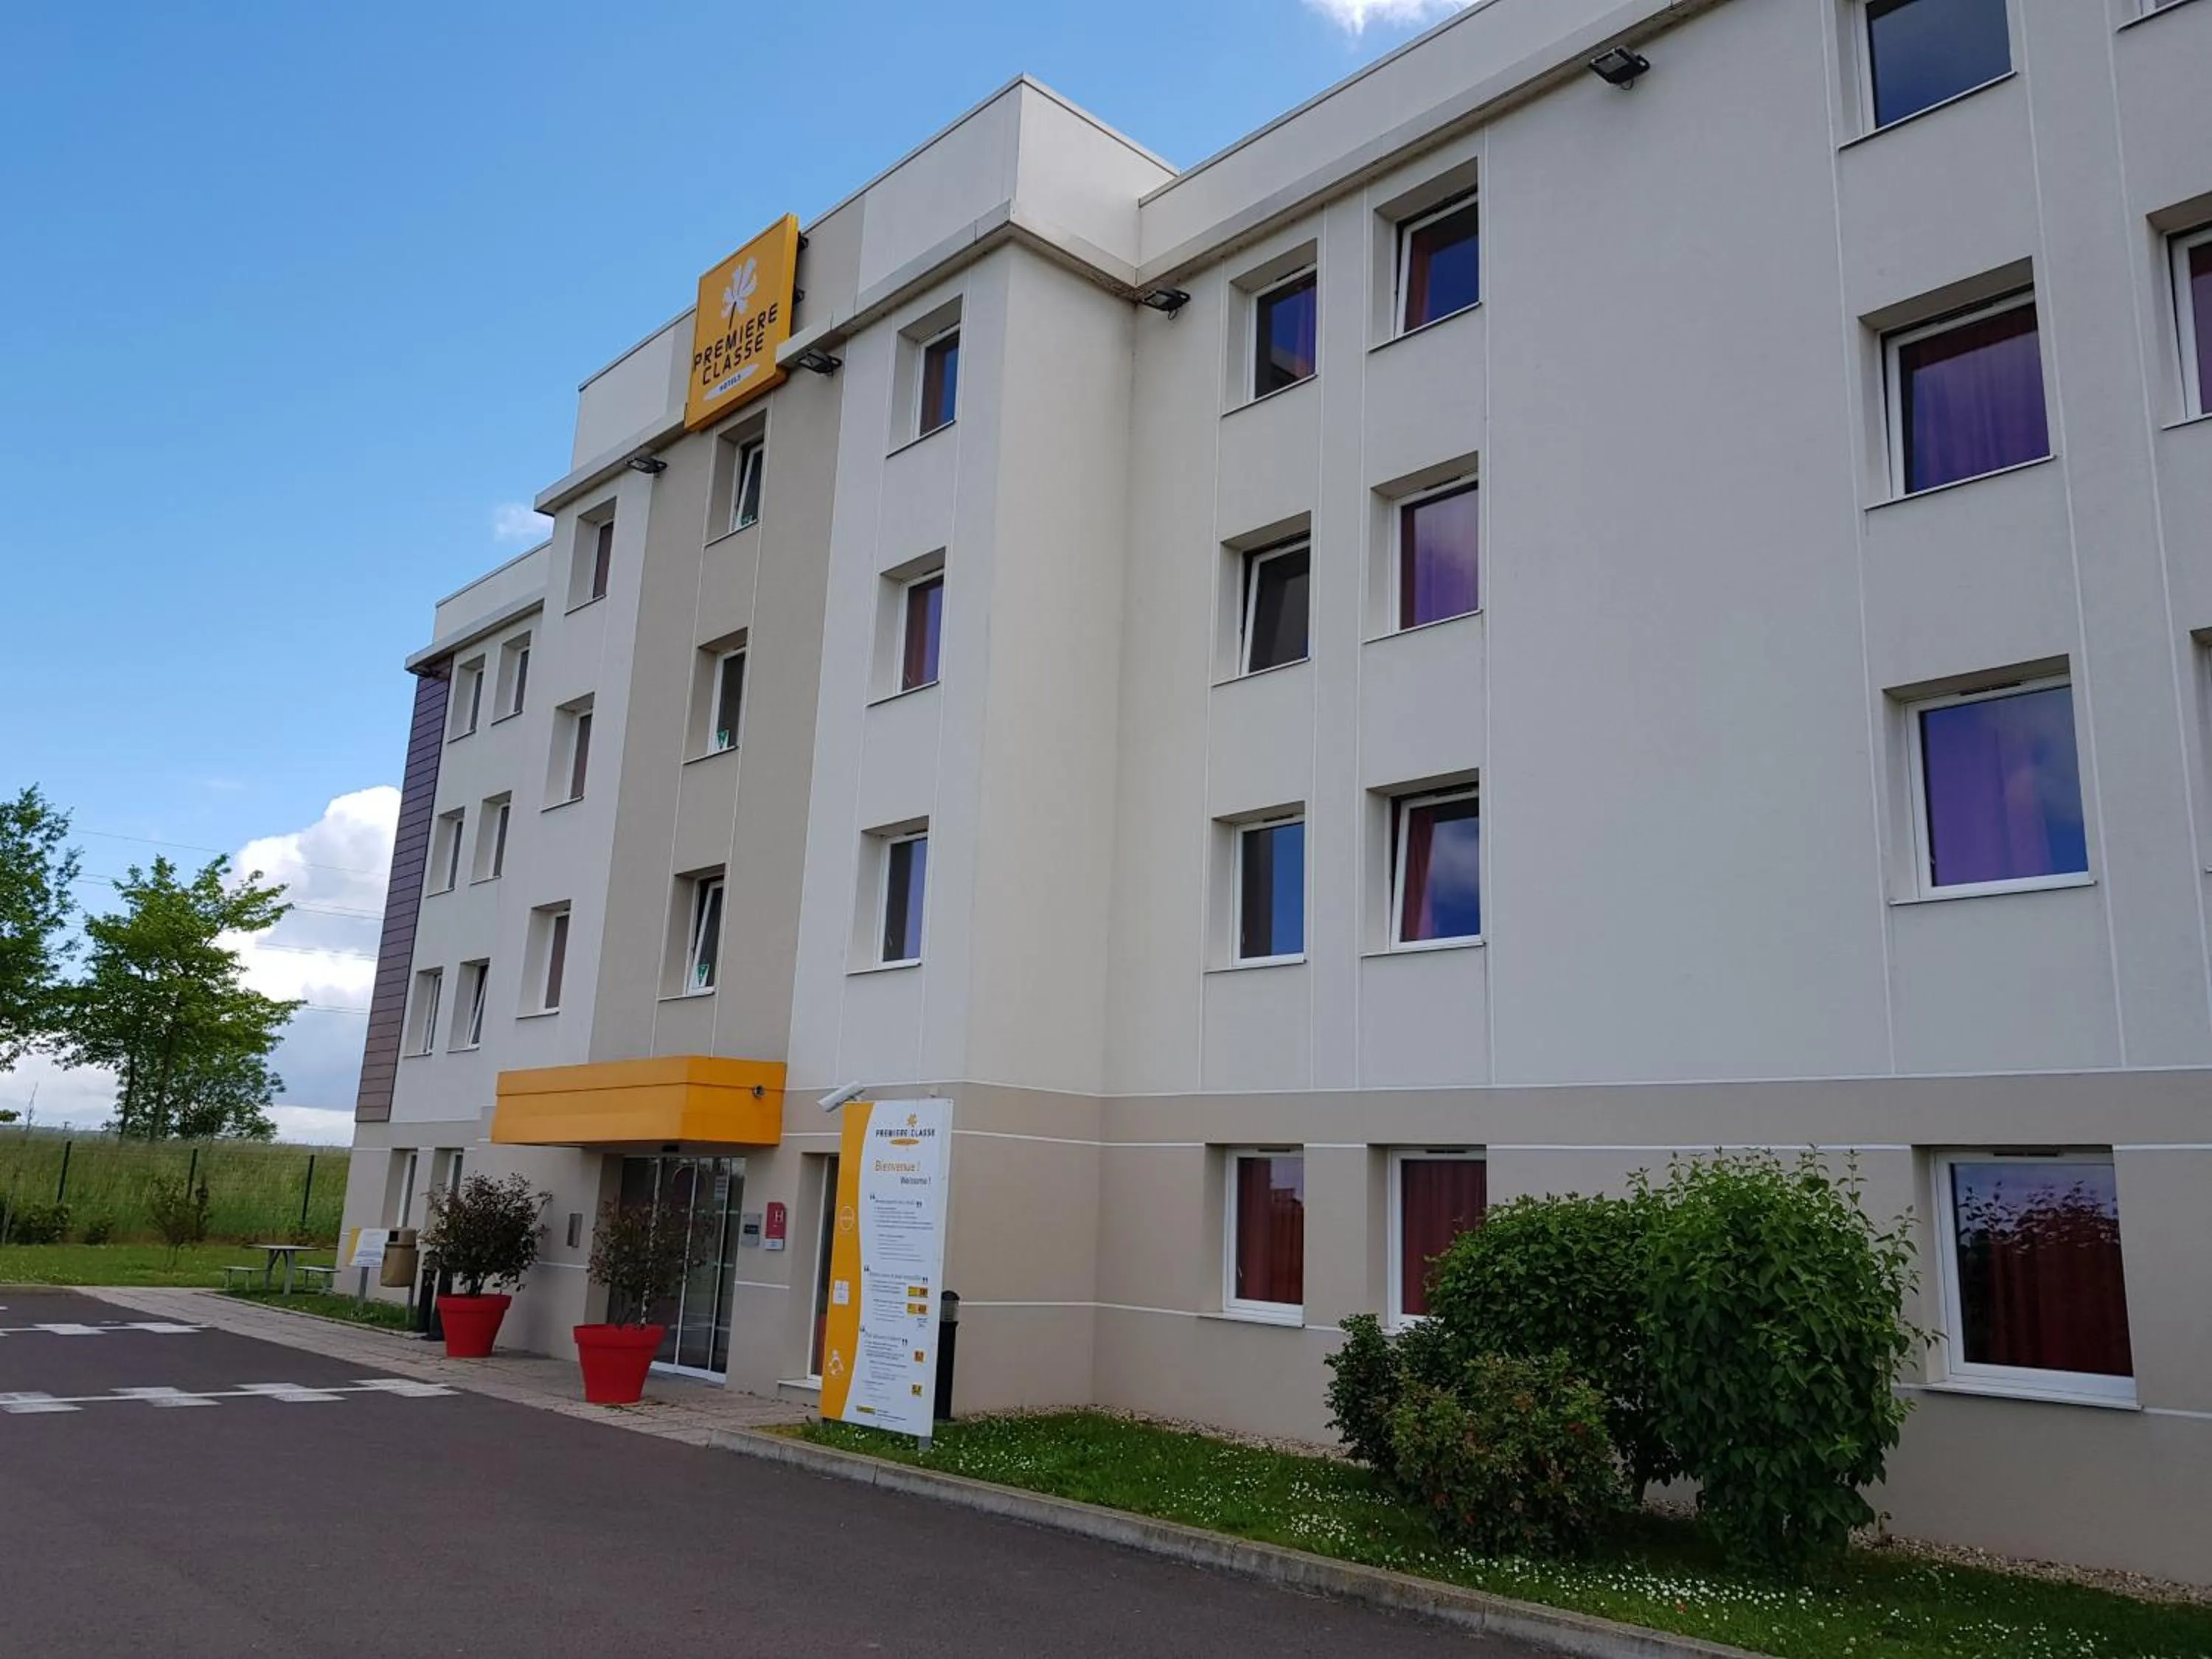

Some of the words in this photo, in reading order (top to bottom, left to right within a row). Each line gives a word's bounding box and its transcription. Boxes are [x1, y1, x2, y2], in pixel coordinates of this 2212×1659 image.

[694, 302, 778, 372] PREMIERE
[703, 331, 765, 386] CLASSE
[875, 1129, 908, 1138] PREMIERE
[911, 1128, 936, 1137] CLASSE
